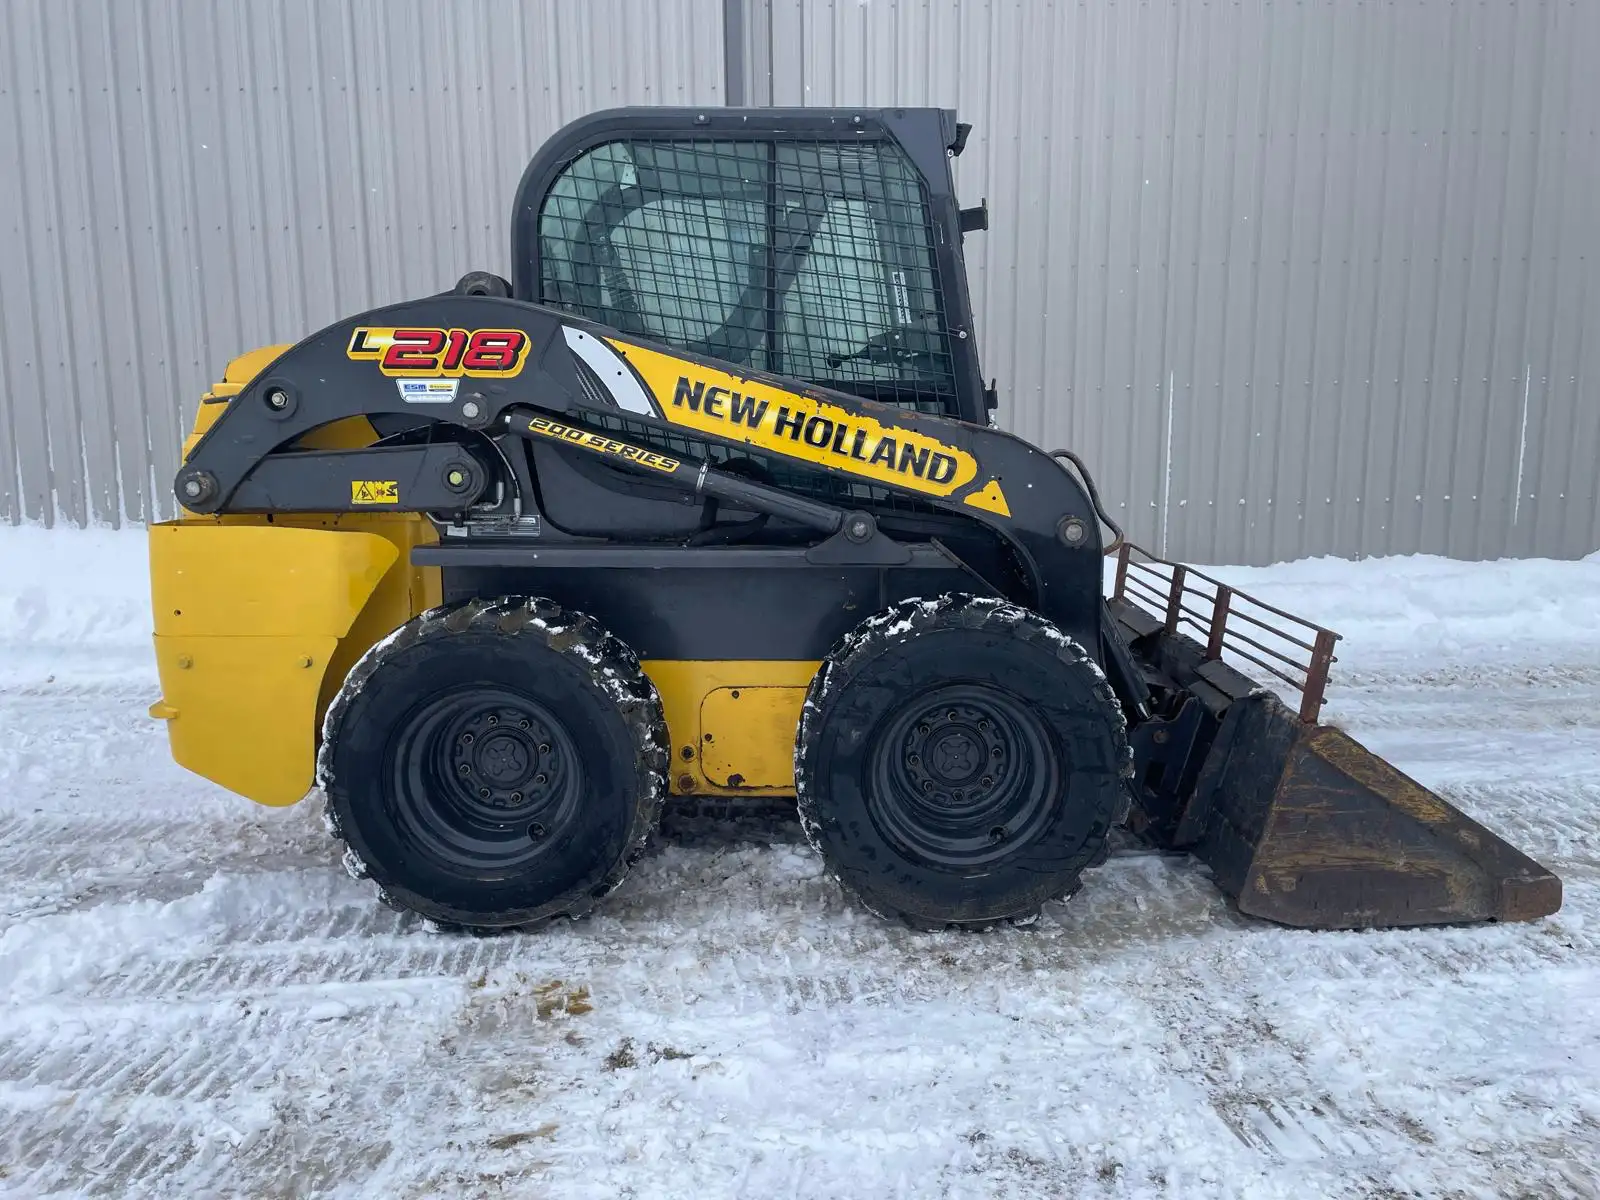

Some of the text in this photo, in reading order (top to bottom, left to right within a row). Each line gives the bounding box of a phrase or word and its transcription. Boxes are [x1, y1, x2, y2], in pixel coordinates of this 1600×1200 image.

[530, 418, 679, 469] 200 SERIES
[672, 376, 957, 484] NEW HOLLAND
